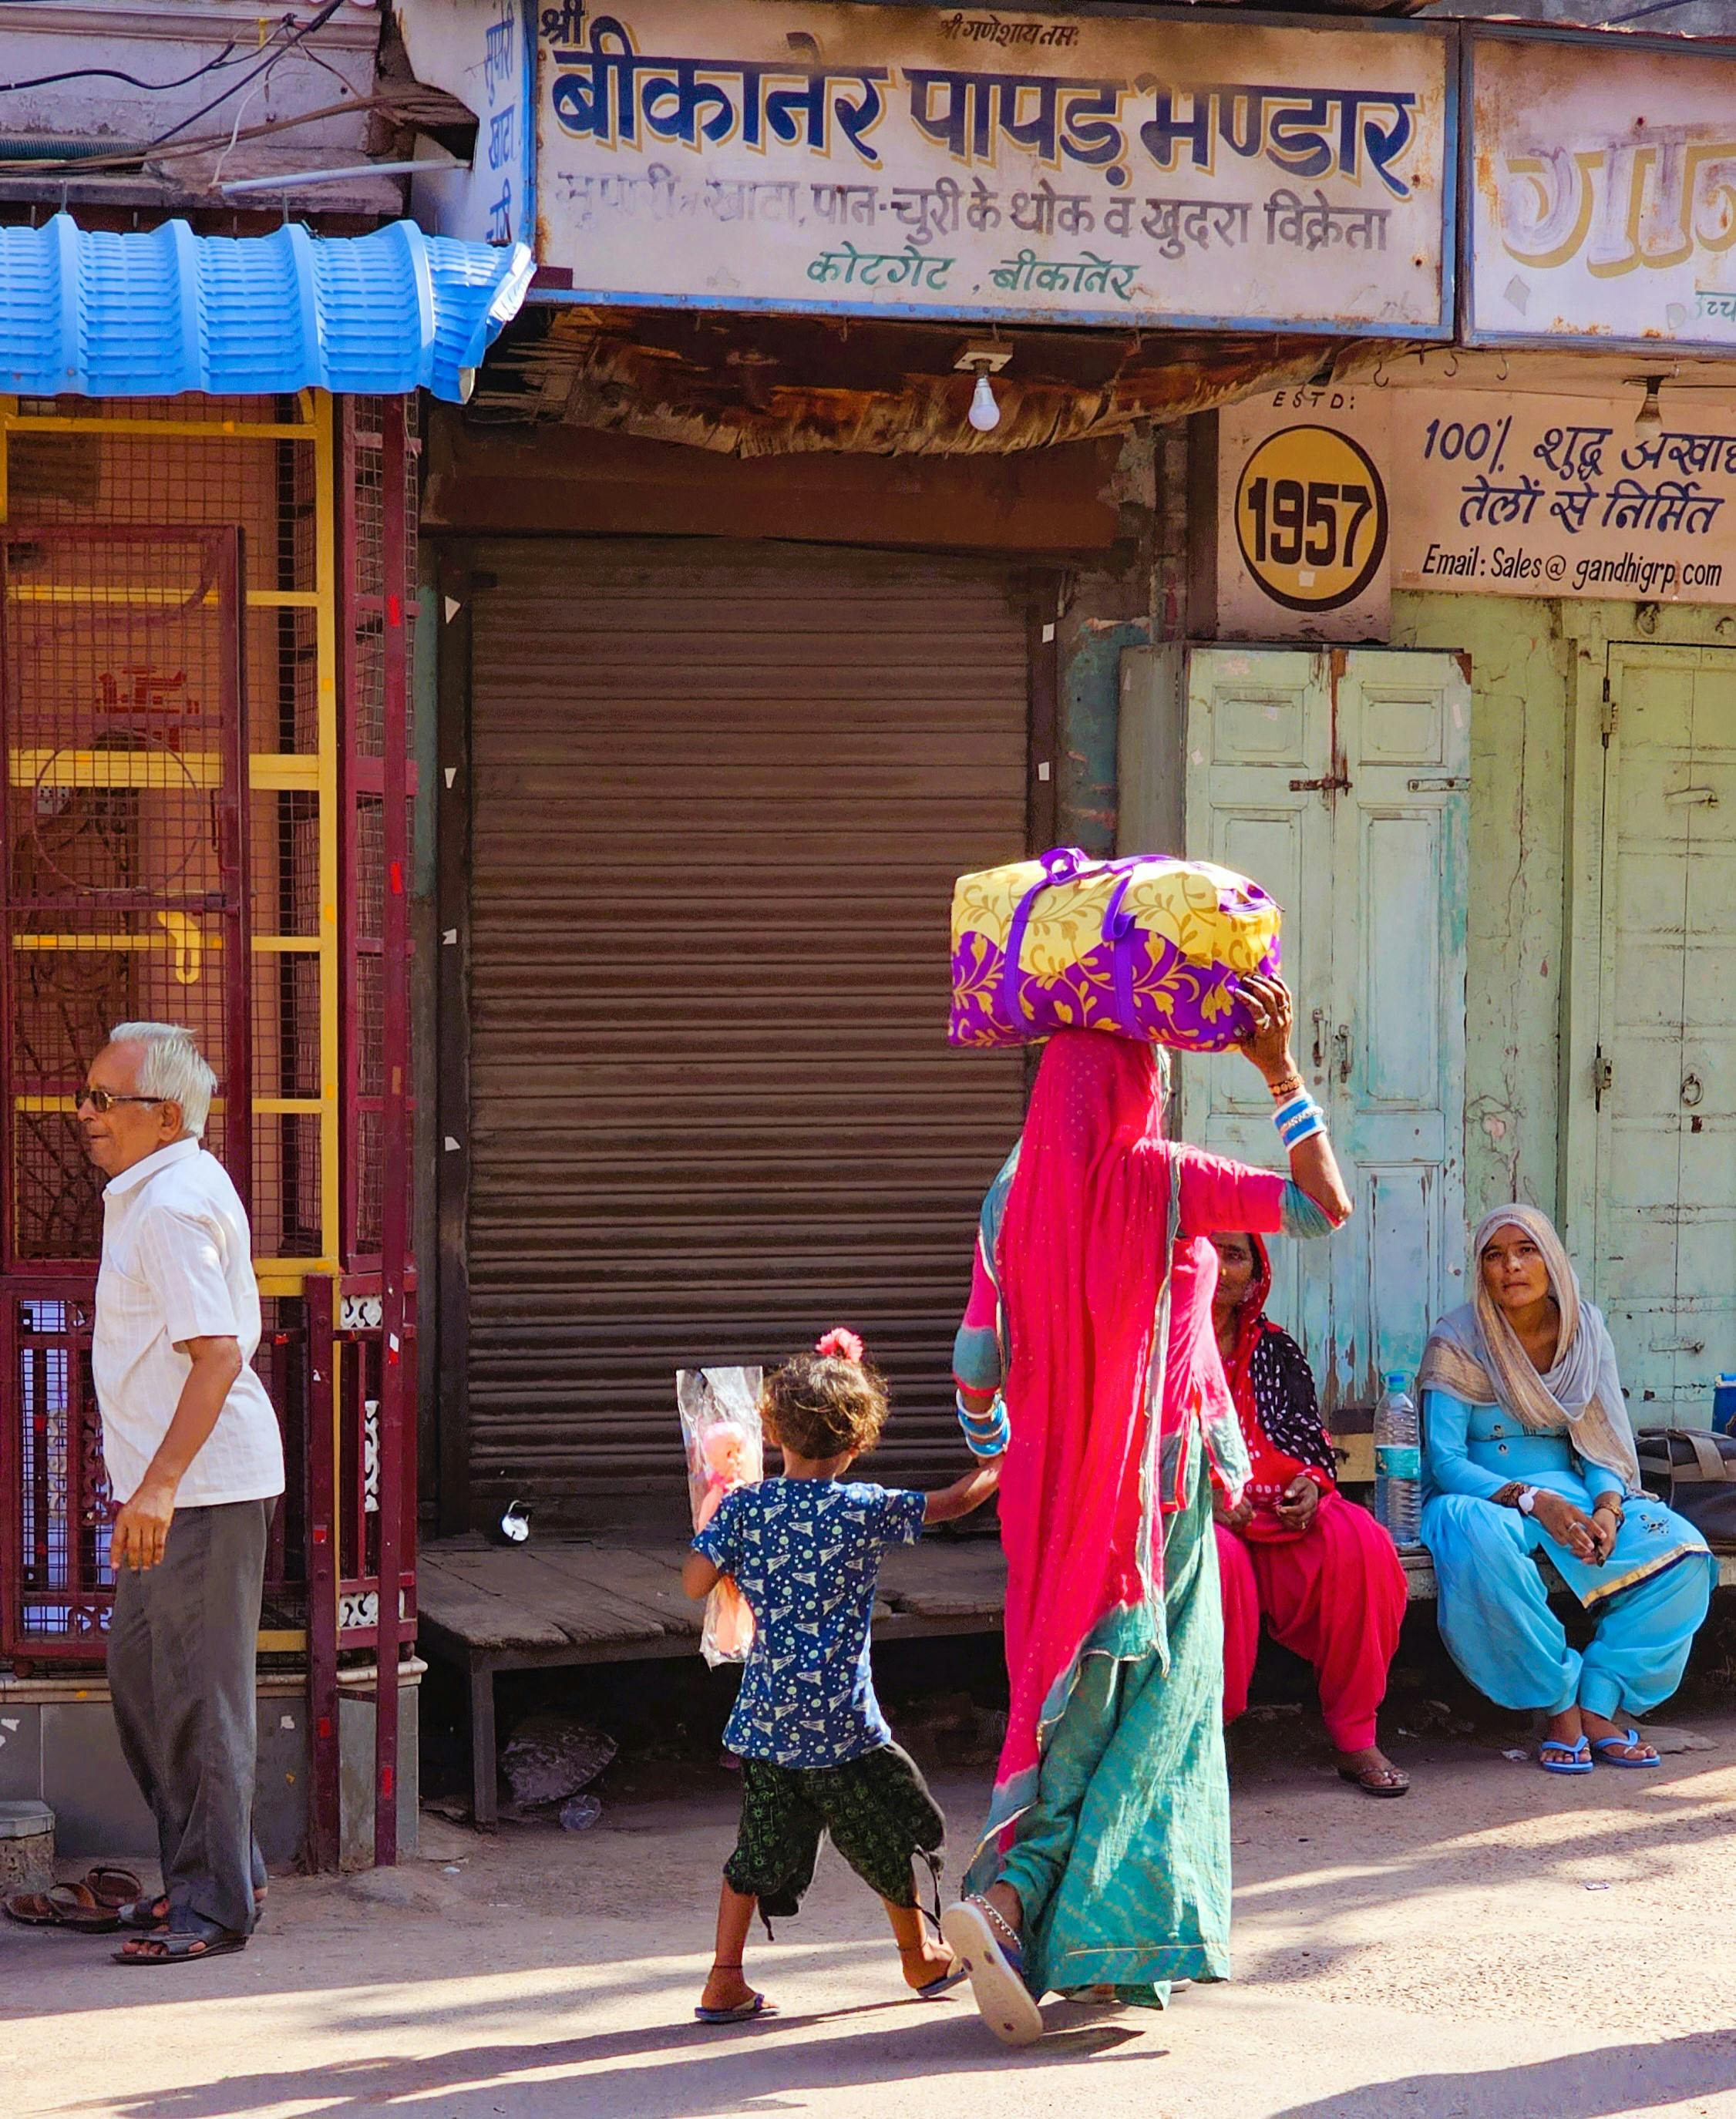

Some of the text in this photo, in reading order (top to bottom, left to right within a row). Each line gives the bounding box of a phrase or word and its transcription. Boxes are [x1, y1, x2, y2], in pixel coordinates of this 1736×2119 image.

[541, 0, 586, 45] श्री
[937, 12, 963, 40] श्री
[964, 15, 1043, 47] गणेशाय
[552, 15, 1417, 196] बीकानेर पापड़ भण्डार
[967, 176, 1001, 232] के
[1010, 178, 1096, 236] थोक
[1104, 197, 1135, 238] व
[1141, 198, 1253, 260] खुदरा
[1263, 188, 1392, 251] विक्रेता
[988, 248, 1142, 301] बीकानेर
[1273, 391, 1355, 409] ESTD:
[1424, 415, 1512, 475] 100%
[1533, 426, 1614, 481] शुद्ध
[1248, 476, 1373, 568] 1957
[1460, 474, 1726, 534] तेलों से निर्मित
[1422, 543, 1486, 577] Email:
